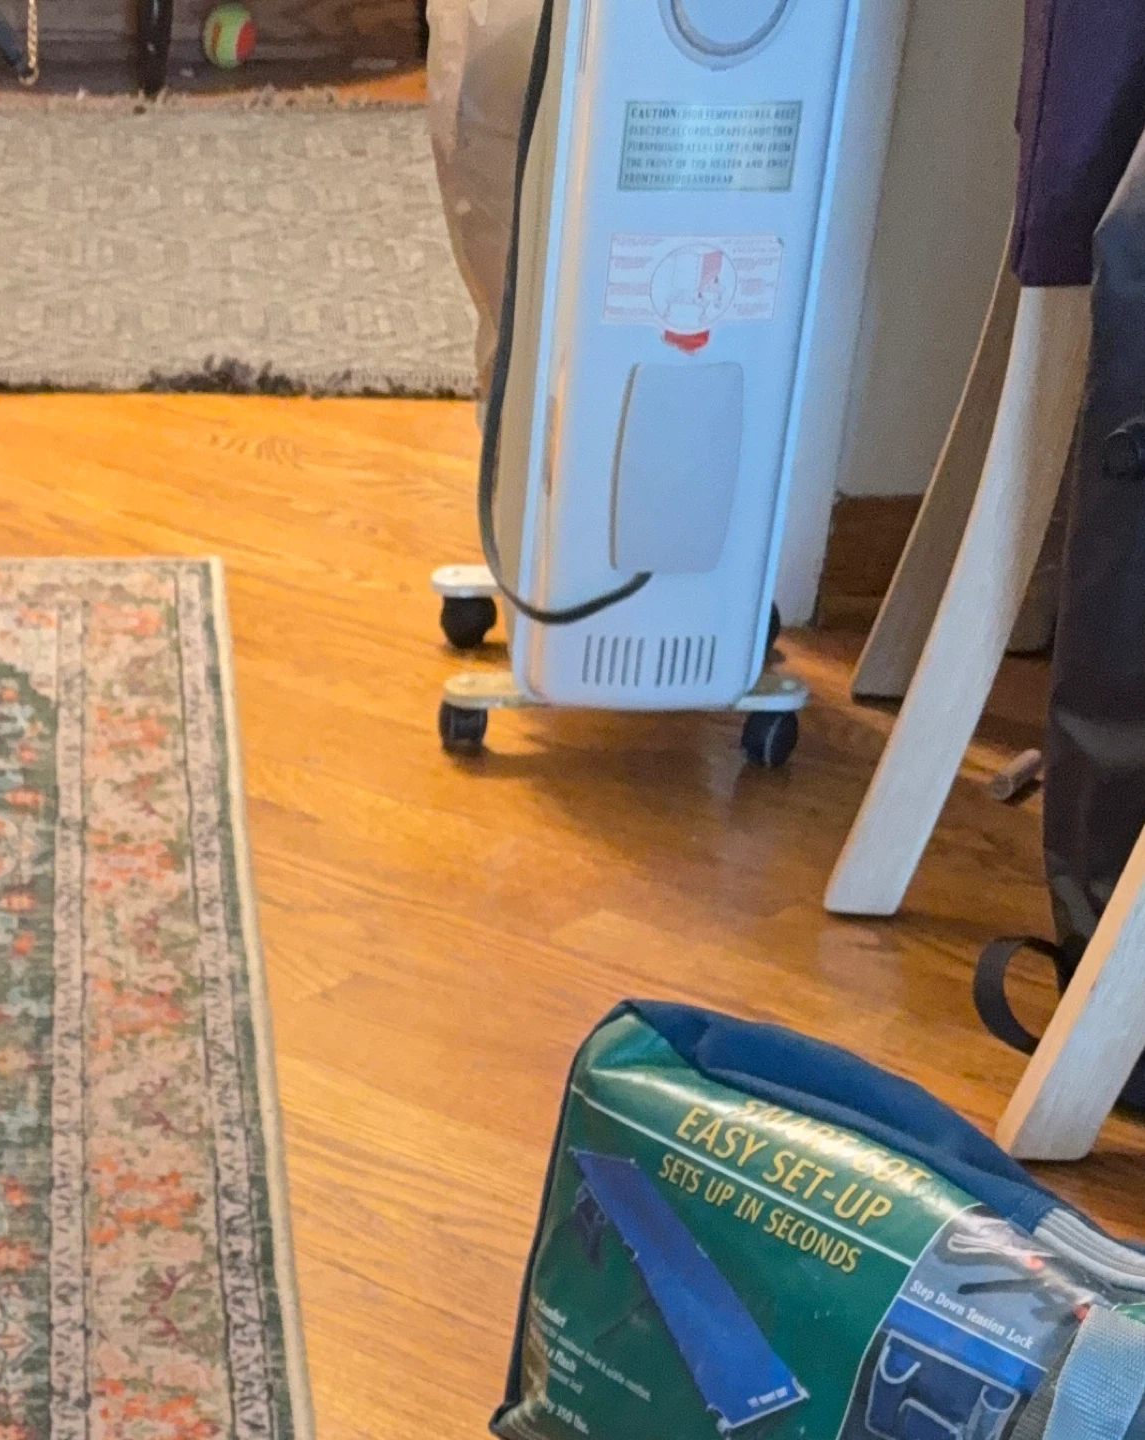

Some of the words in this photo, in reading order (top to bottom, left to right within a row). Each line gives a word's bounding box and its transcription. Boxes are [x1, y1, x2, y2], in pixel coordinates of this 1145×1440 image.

[658, 1153, 703, 1194] SETS
[704, 1176, 736, 1208] UP
[734, 1192, 766, 1224] IN
[763, 1207, 863, 1274] SECONDS
[675, 1106, 769, 1168] EASY
[762, 1150, 893, 1227] SET-UP
[910, 1280, 935, 1303] Step
[935, 1292, 966, 1316] Down
[966, 1307, 1006, 1337] Tension
[1006, 1327, 1034, 1350] Lock
